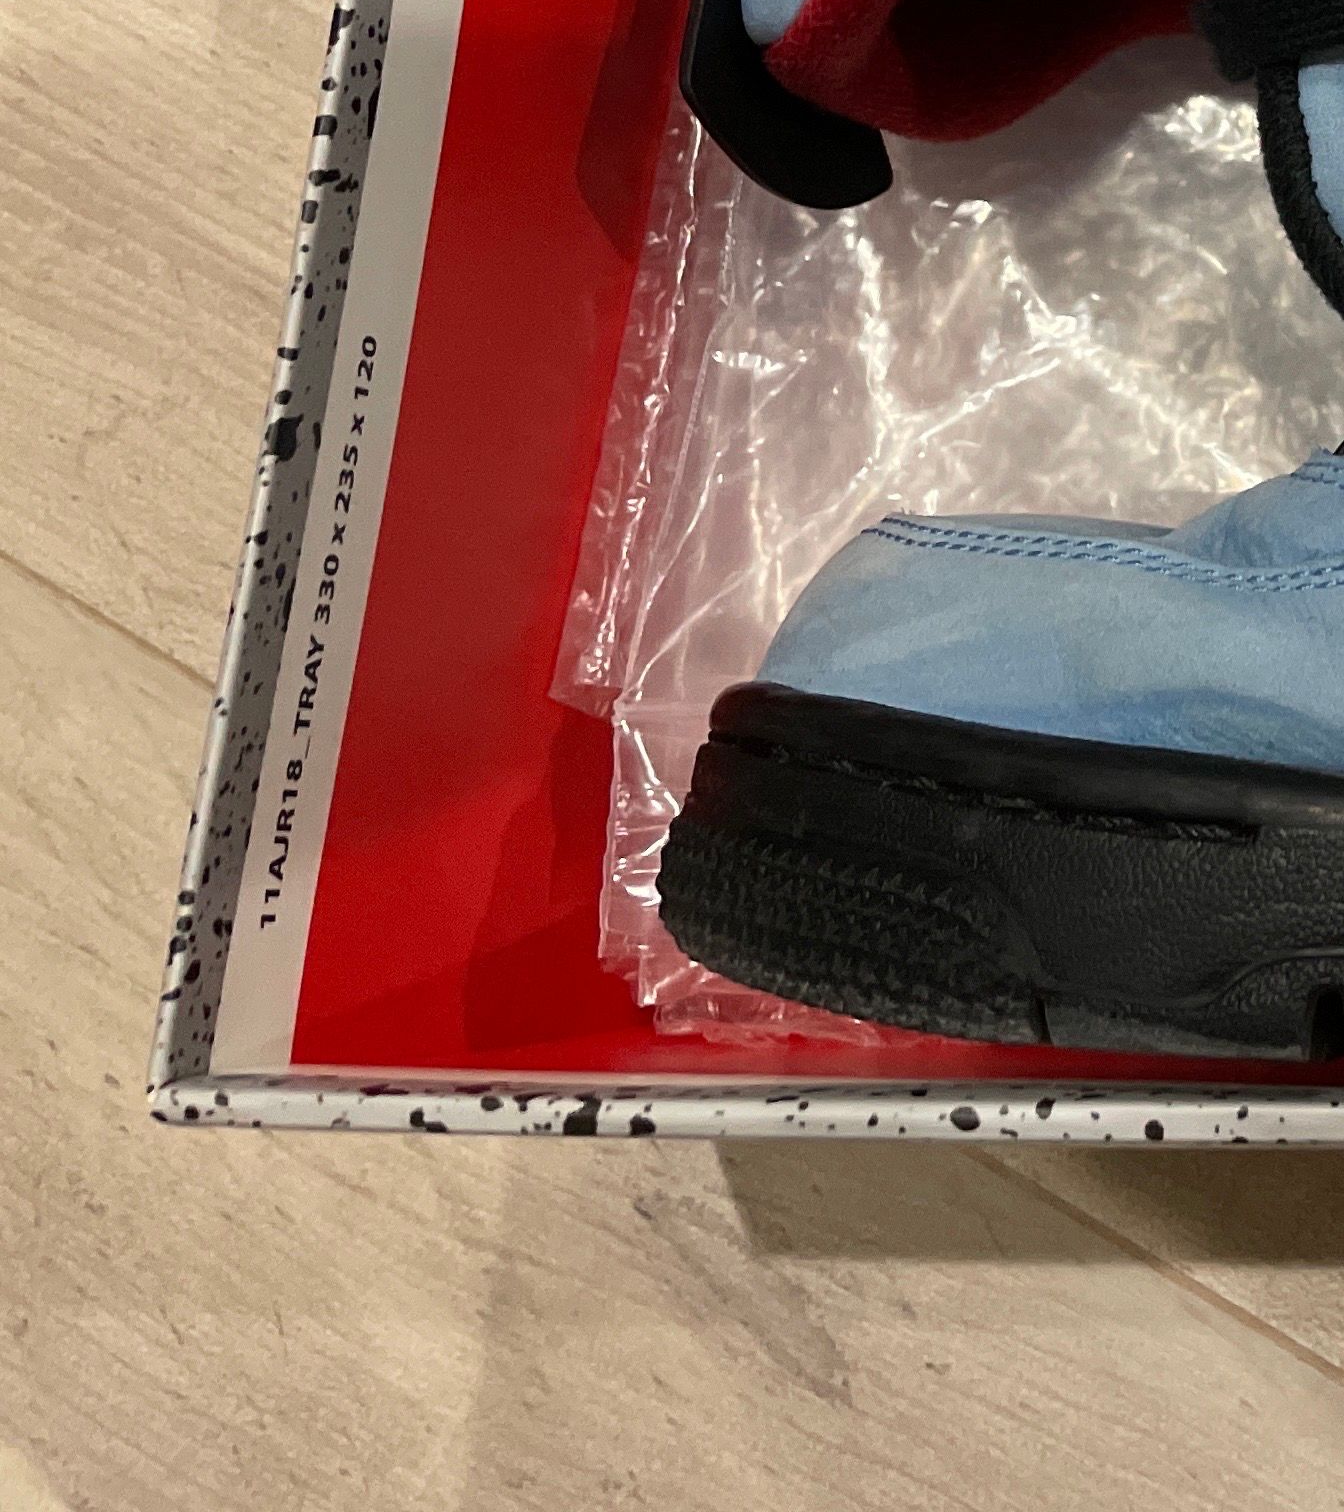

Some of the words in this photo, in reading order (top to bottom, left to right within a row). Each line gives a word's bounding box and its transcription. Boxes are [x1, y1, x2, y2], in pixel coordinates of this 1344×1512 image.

[353, 335, 378, 401] 120
[349, 412, 366, 437] x
[333, 442, 359, 515] 235
[330, 521, 347, 546] x
[313, 553, 340, 626] 330
